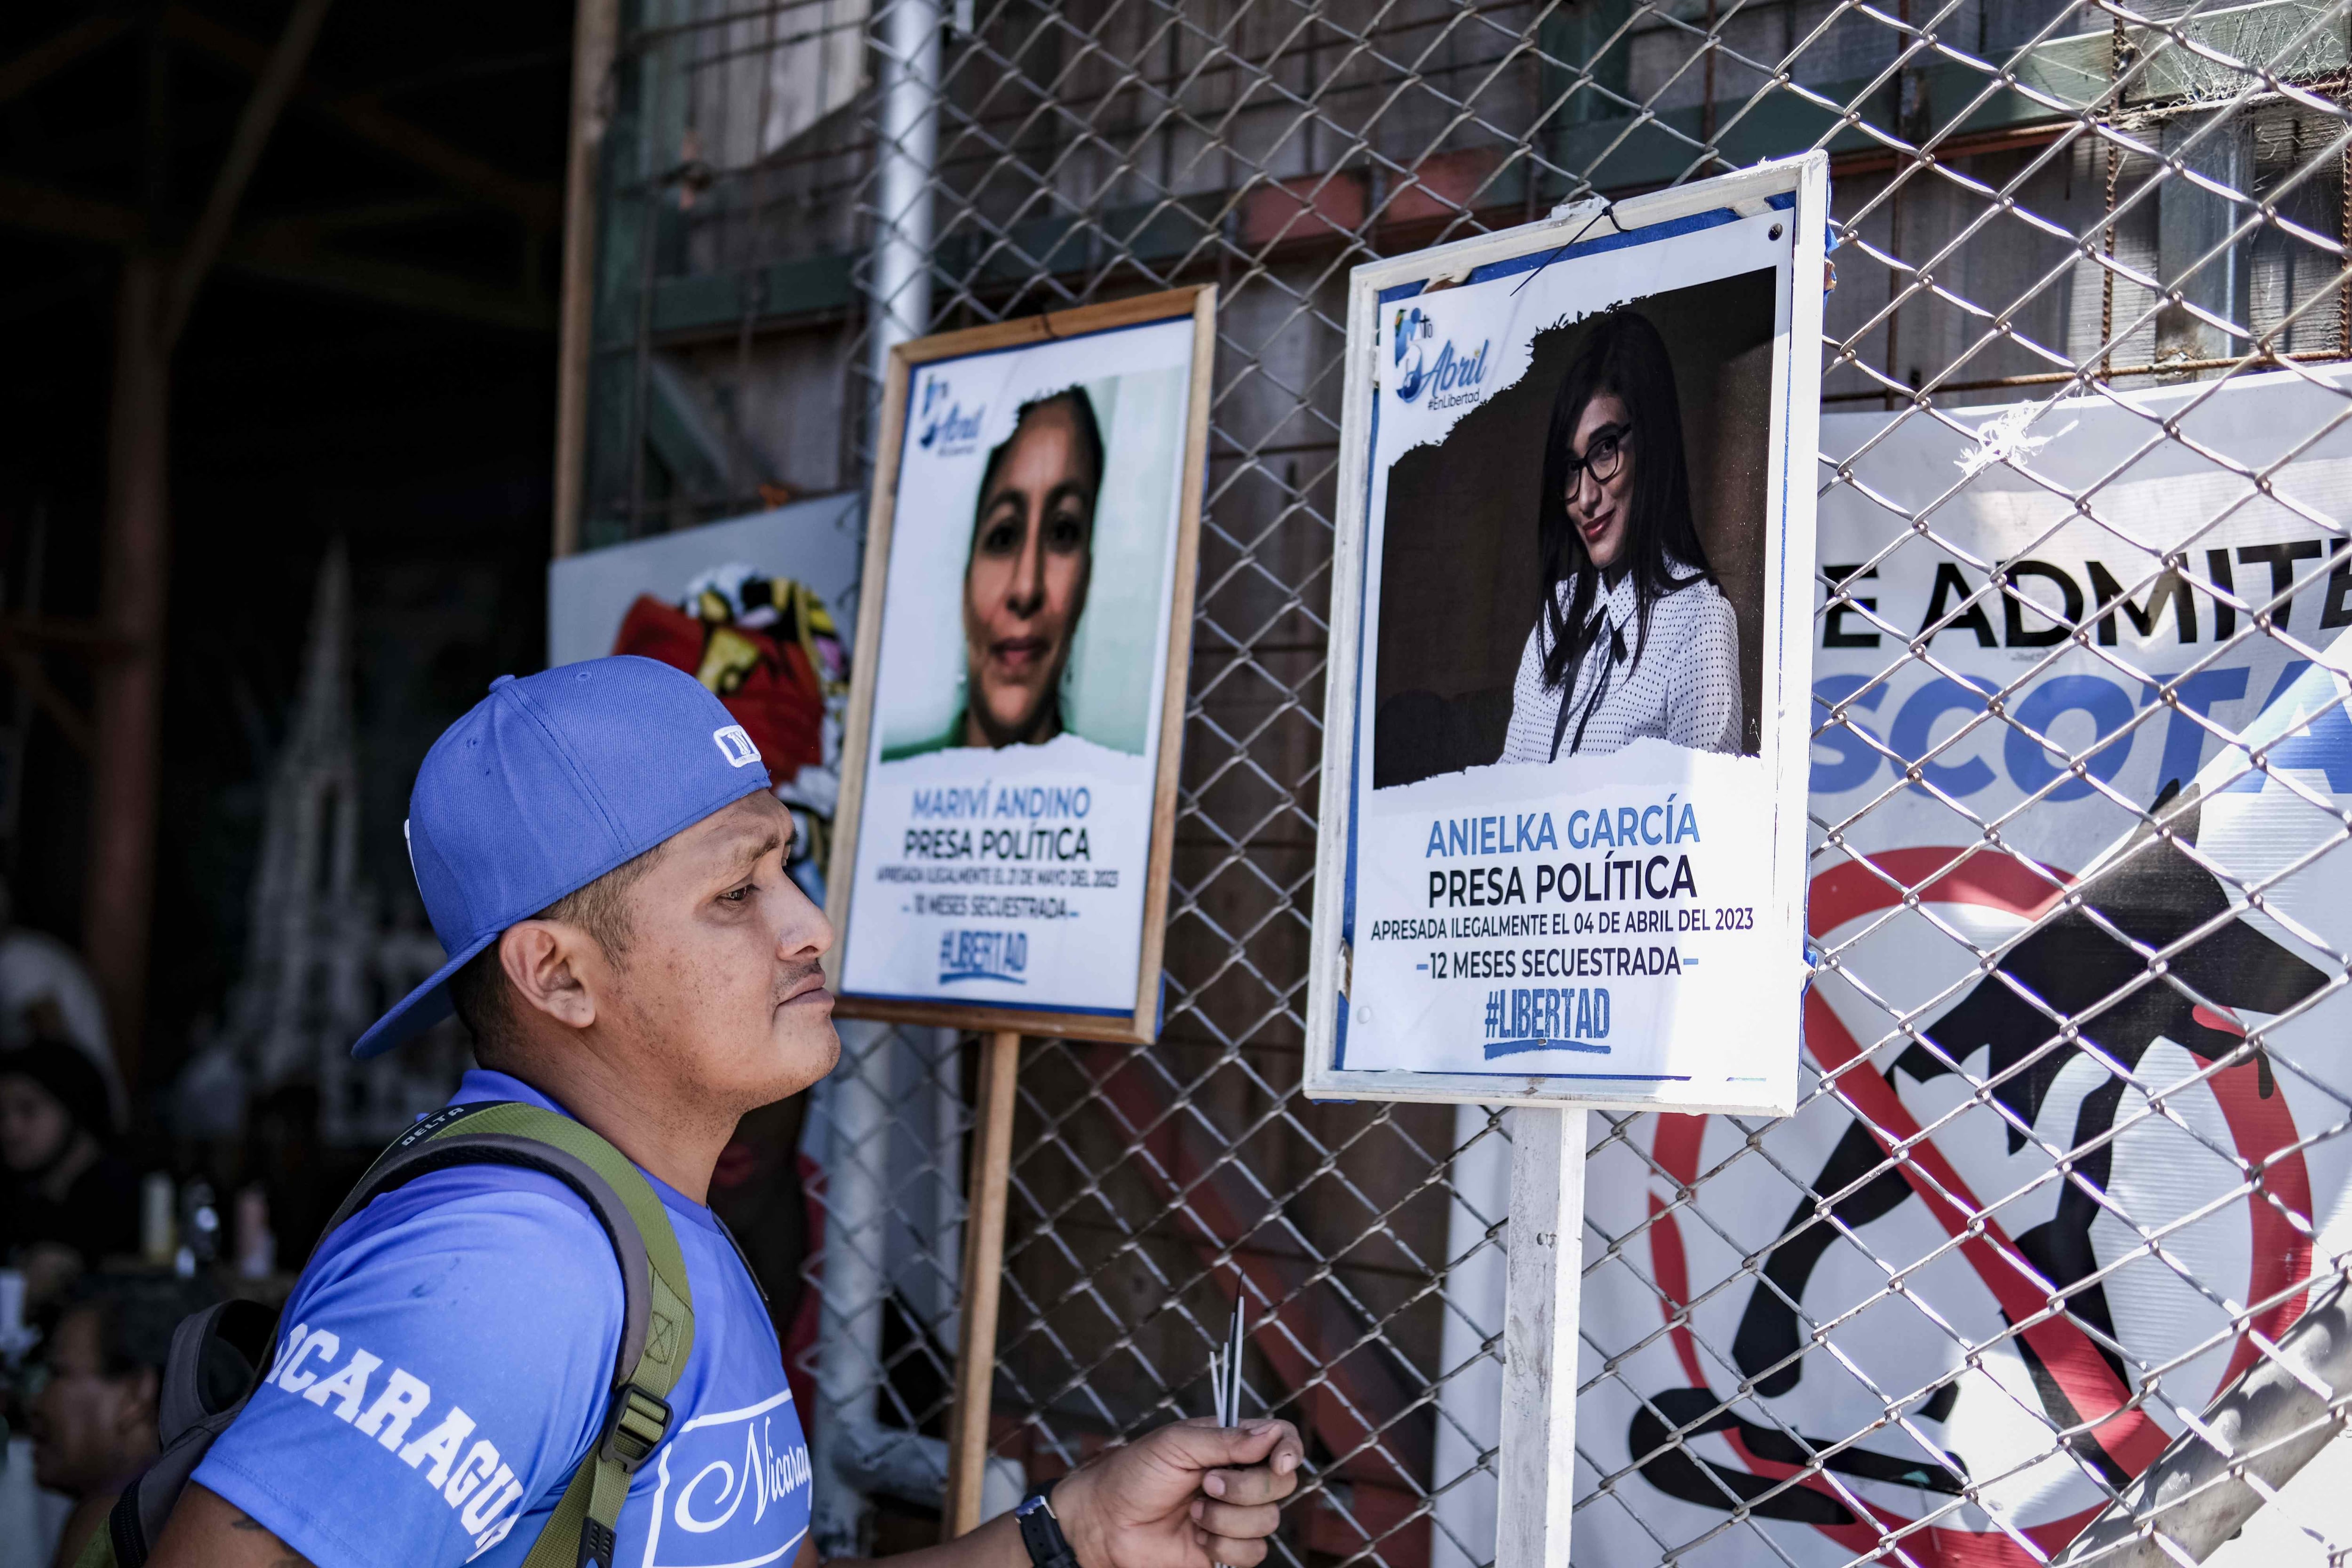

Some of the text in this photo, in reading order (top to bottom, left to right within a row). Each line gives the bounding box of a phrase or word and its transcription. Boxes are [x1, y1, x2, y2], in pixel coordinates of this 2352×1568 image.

[993, 787, 1091, 819] ANDINO
[904, 821, 1091, 861] PRESA POLÍTICA
[1425, 793, 1700, 858] ANIELKA GARCÍA
[1429, 851, 1697, 908] PRESA POLÍTICA
[1371, 907, 1754, 941] APRESADA ILEGALMENTE EL 04 DE ABRIL DEL 2023
[1454, 950, 1517, 979] MESES
[1485, 988, 1611, 1040] #LIBERTAD
[401, 1107, 464, 1146] DELTA
